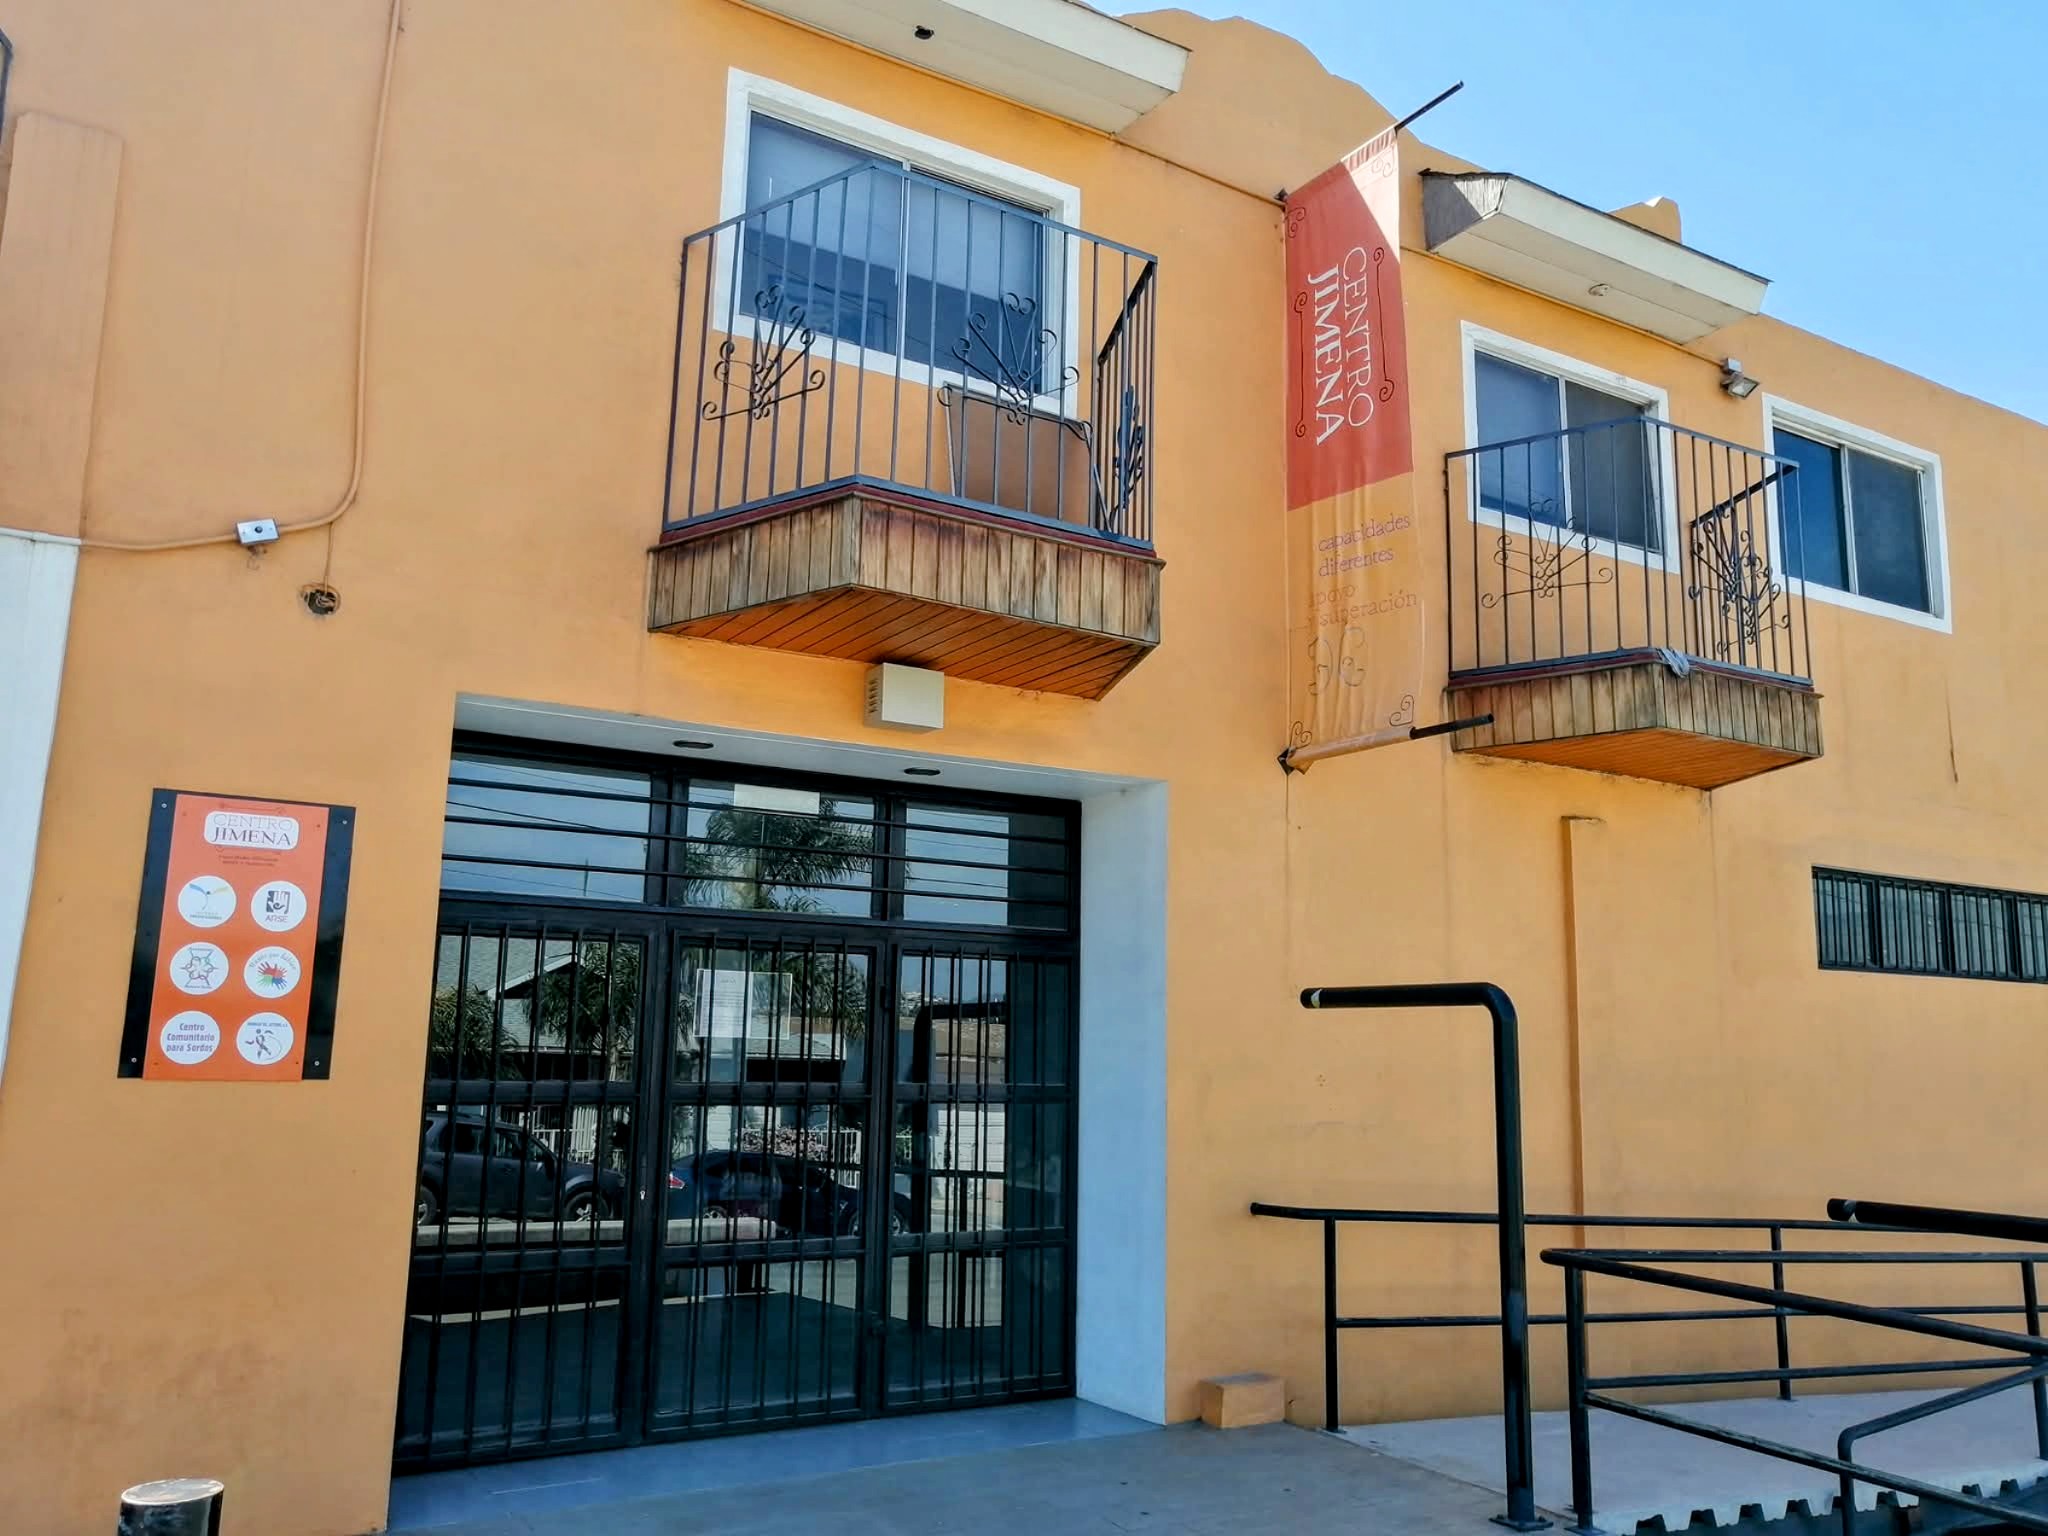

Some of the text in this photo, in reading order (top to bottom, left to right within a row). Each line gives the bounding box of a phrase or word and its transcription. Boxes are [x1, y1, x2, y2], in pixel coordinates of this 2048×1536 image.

[1343, 247, 1375, 427] CENTRO
[1308, 264, 1345, 446] JIMENA
[1318, 513, 1411, 553] capacidades
[1318, 547, 1394, 577] diferentes
[1319, 589, 1417, 627] superación
[213, 813, 293, 831] CENTRO
[211, 827, 291, 846] JIMENA
[167, 1033, 215, 1042] Comunitario
[179, 1022, 205, 1031] Centro
[187, 1044, 213, 1052] Sordos
